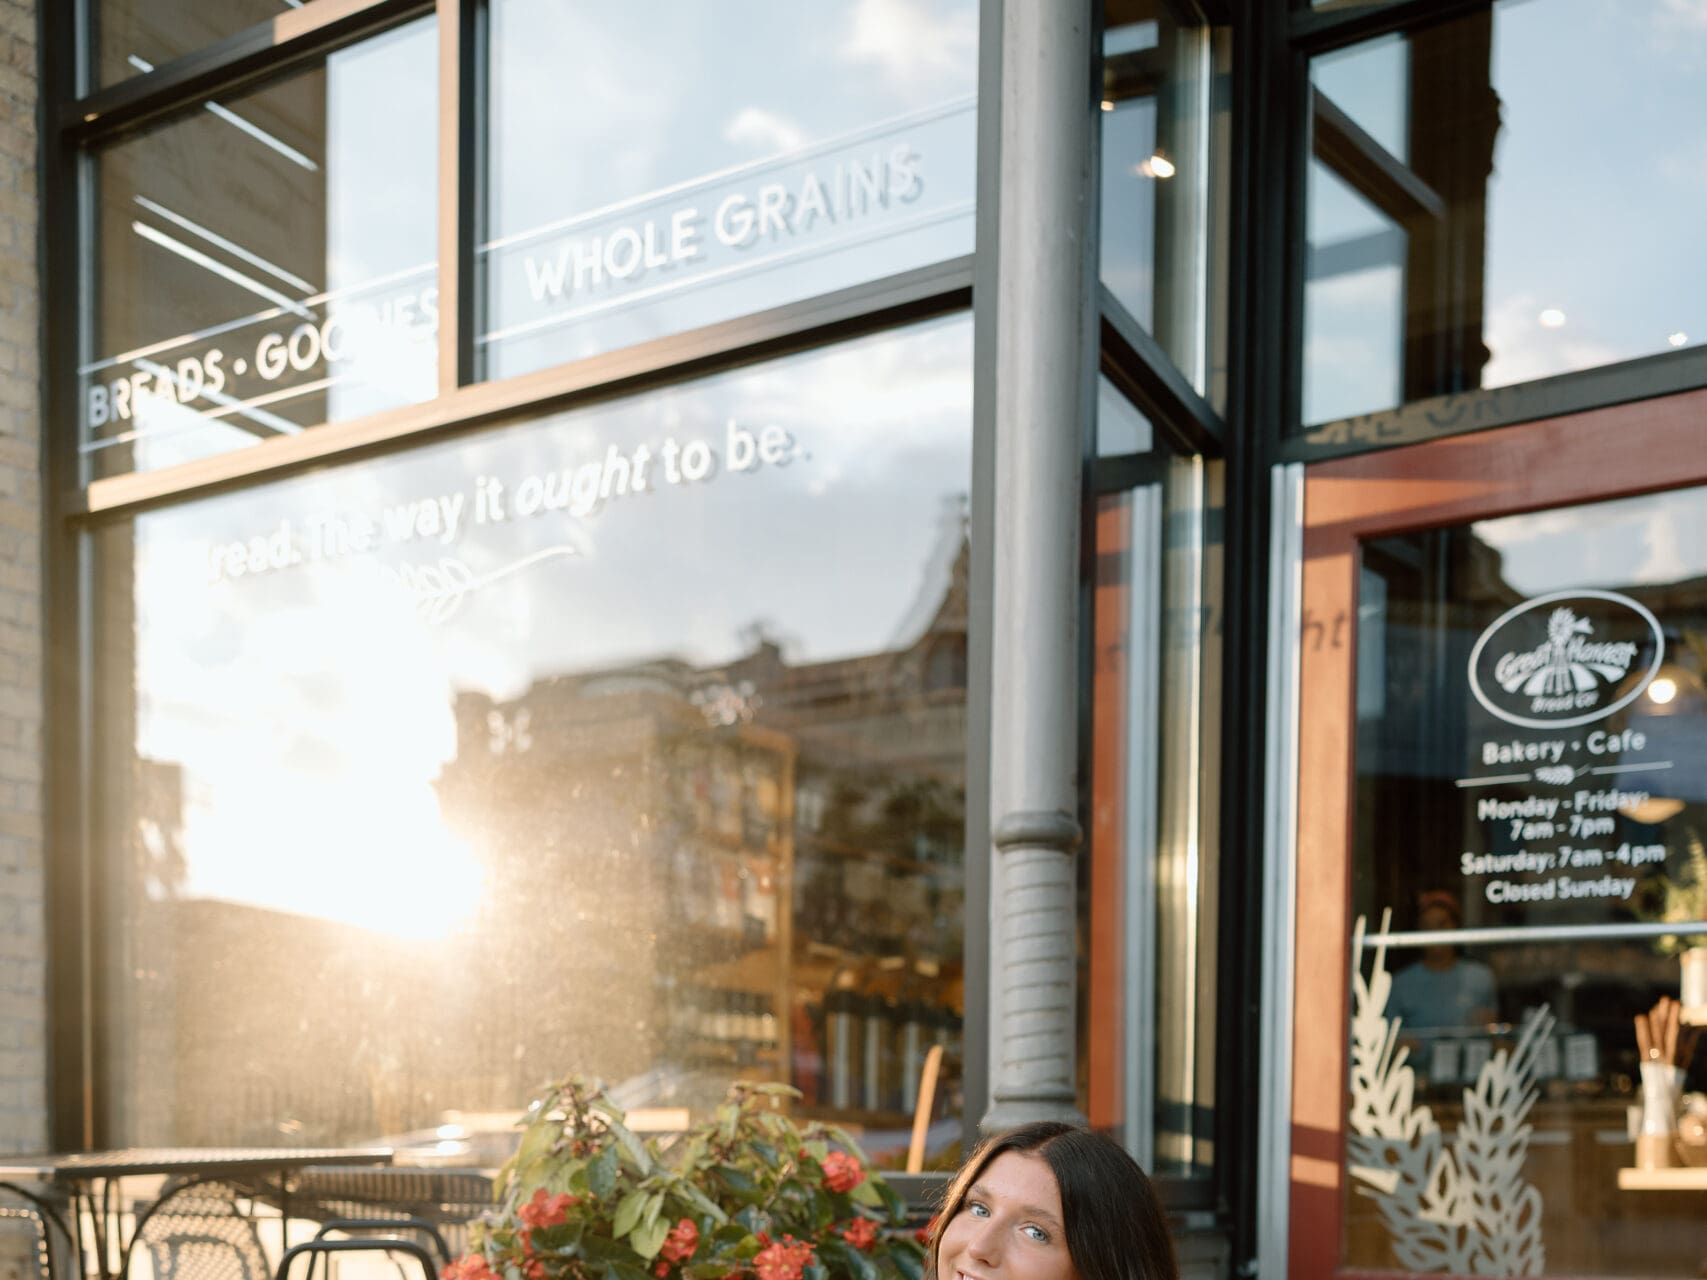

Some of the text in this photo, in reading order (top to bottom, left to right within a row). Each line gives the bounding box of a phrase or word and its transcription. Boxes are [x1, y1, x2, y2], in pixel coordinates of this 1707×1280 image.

[524, 143, 920, 301] WHOLE GRAINS
[88, 348, 226, 428] BREADS
[384, 492, 465, 545] way
[474, 474, 505, 525] it
[515, 443, 651, 518] ought
[663, 436, 712, 485] to
[726, 418, 804, 472] be.
[1482, 739, 1566, 765] Bakery
[1586, 728, 1647, 755] Cafe
[1477, 796, 1560, 821] Monday
[1461, 850, 1556, 876] Saturday:
[1485, 874, 1637, 903] Closed Sunday
